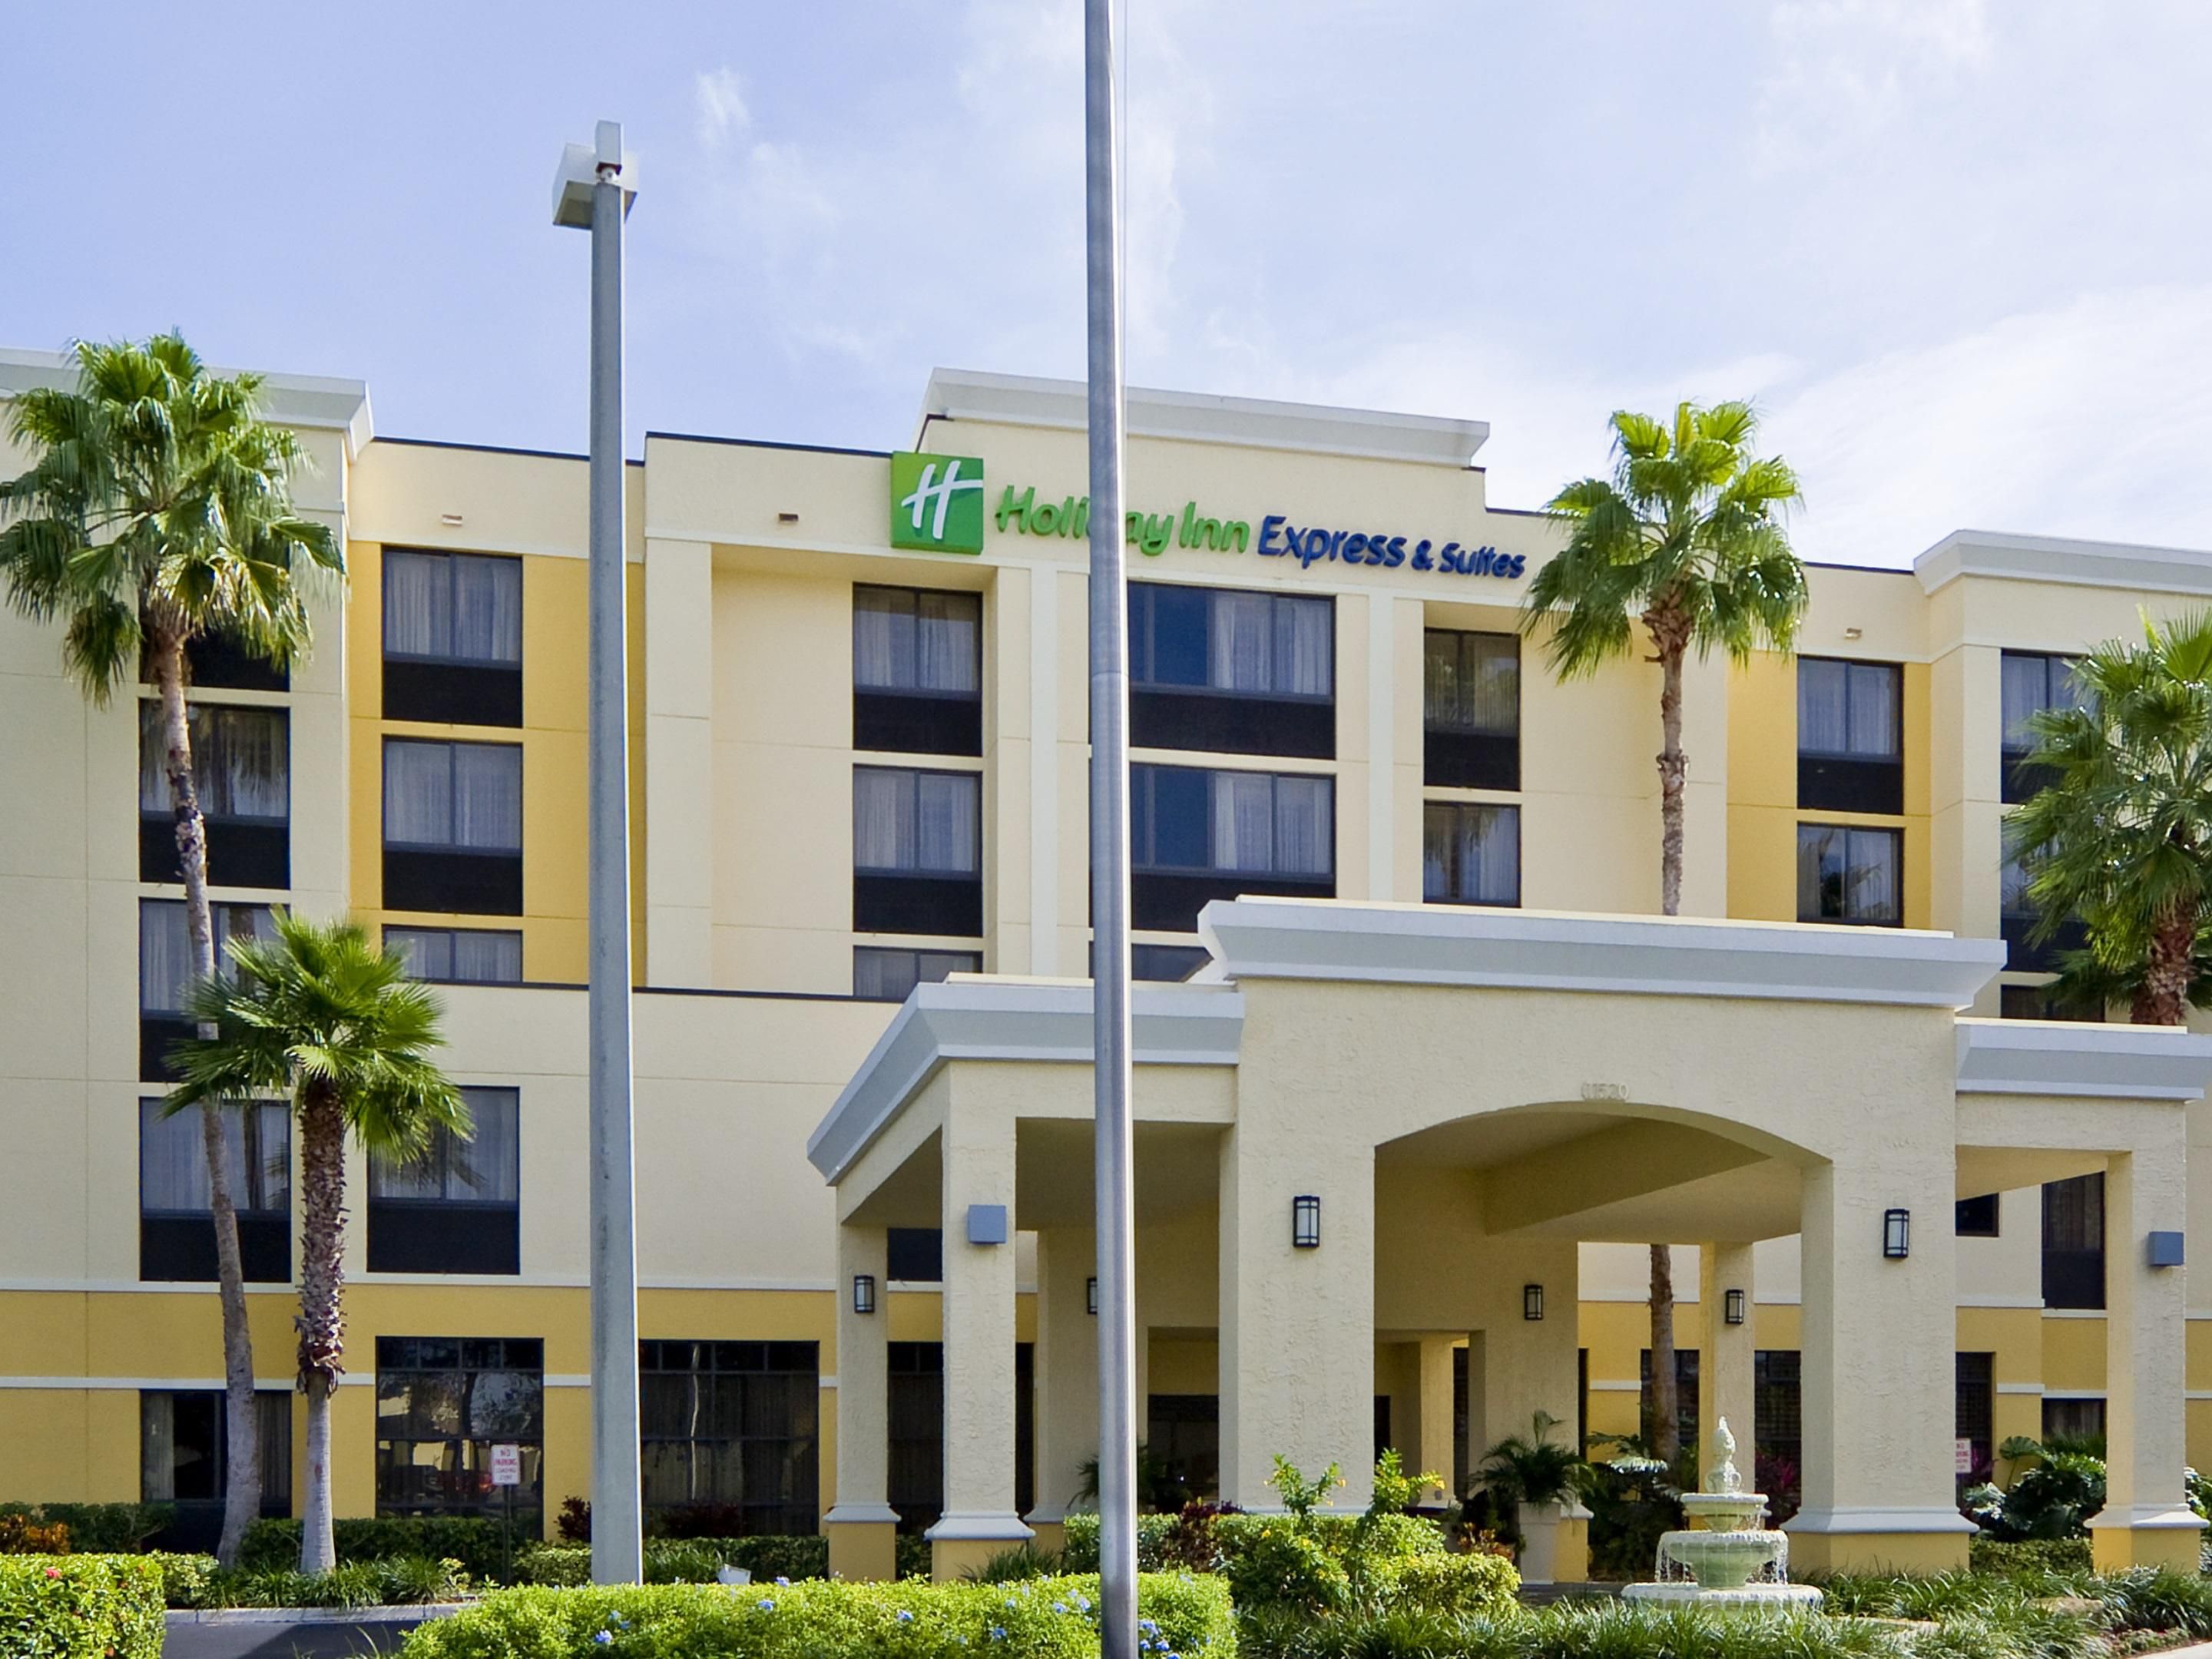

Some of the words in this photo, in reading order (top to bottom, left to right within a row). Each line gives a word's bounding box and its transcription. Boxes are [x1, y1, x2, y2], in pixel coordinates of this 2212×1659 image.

[995, 485, 1174, 556] Holiay
[1179, 502, 1250, 553] Inn
[1257, 515, 1407, 569] Express
[1411, 539, 1434, 571] &
[1438, 543, 1526, 578] Suites
